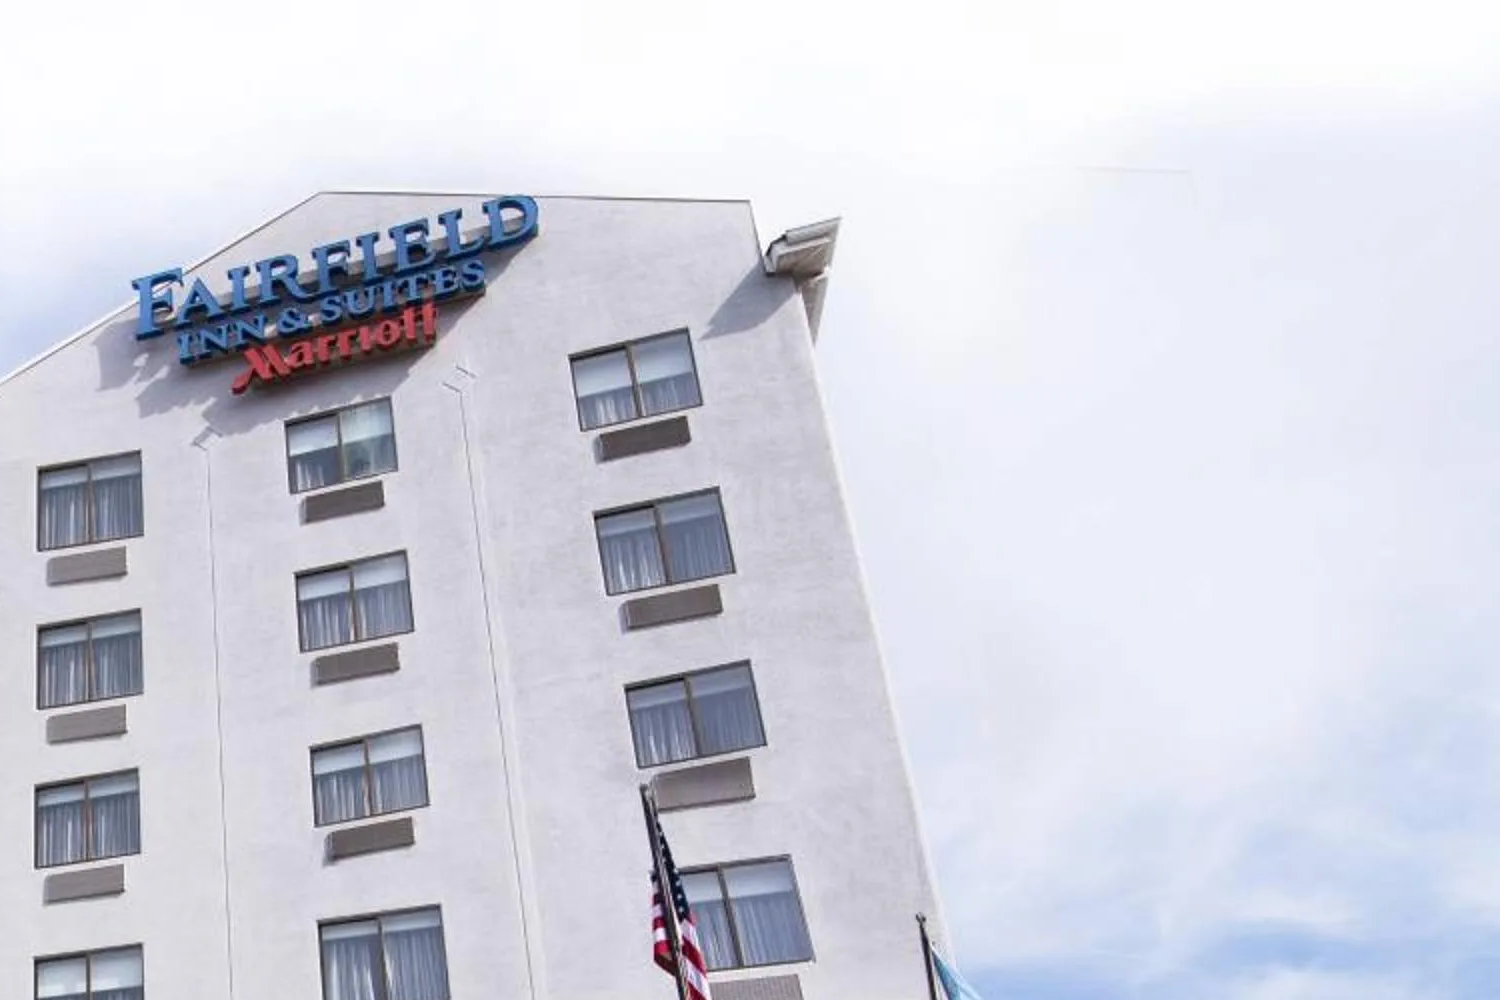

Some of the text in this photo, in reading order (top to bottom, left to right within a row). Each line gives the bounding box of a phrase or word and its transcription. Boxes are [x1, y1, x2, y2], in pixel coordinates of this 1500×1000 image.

[131, 194, 539, 341] FAIRFIELD
[176, 258, 486, 366] INN & SUITES
[229, 301, 440, 395] Marriott
